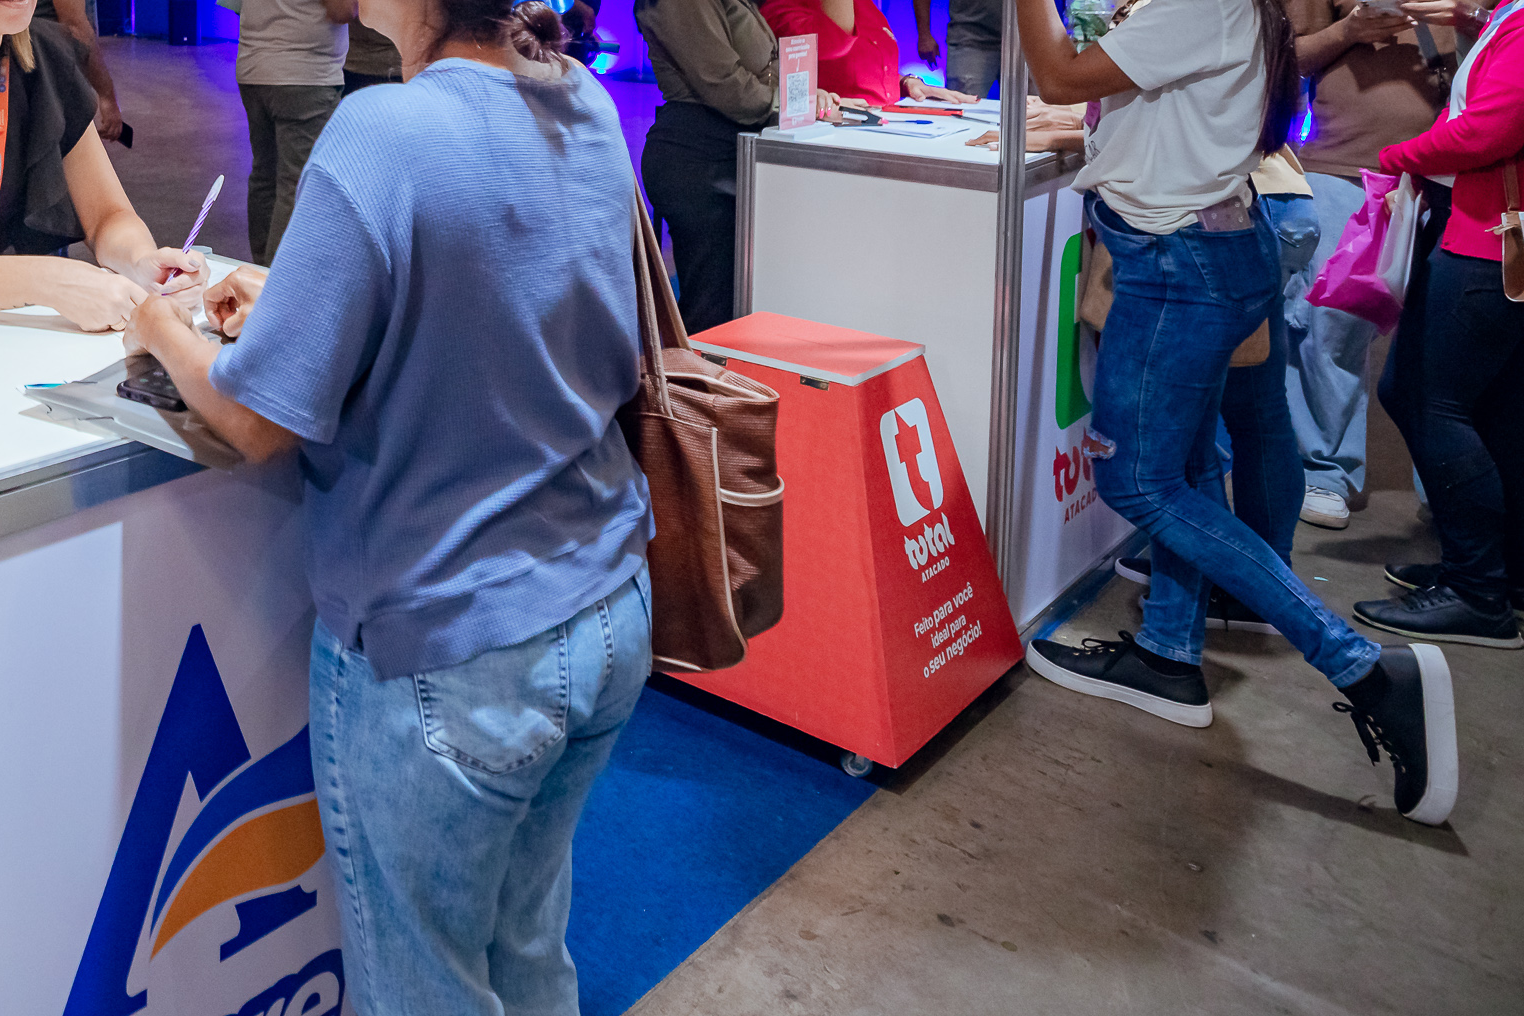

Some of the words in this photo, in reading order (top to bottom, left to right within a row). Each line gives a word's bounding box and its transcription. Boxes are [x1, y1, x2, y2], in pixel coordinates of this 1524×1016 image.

[904, 511, 956, 570] total
[921, 556, 950, 583] ATACADO
[914, 616, 934, 638] Feito
[933, 600, 953, 627] para
[953, 582, 973, 609] você
[930, 623, 950, 649] ideal
[949, 614, 967, 638] para
[923, 666, 930, 678] o
[929, 651, 947, 674] seu
[946, 619, 983, 662] negócio!
